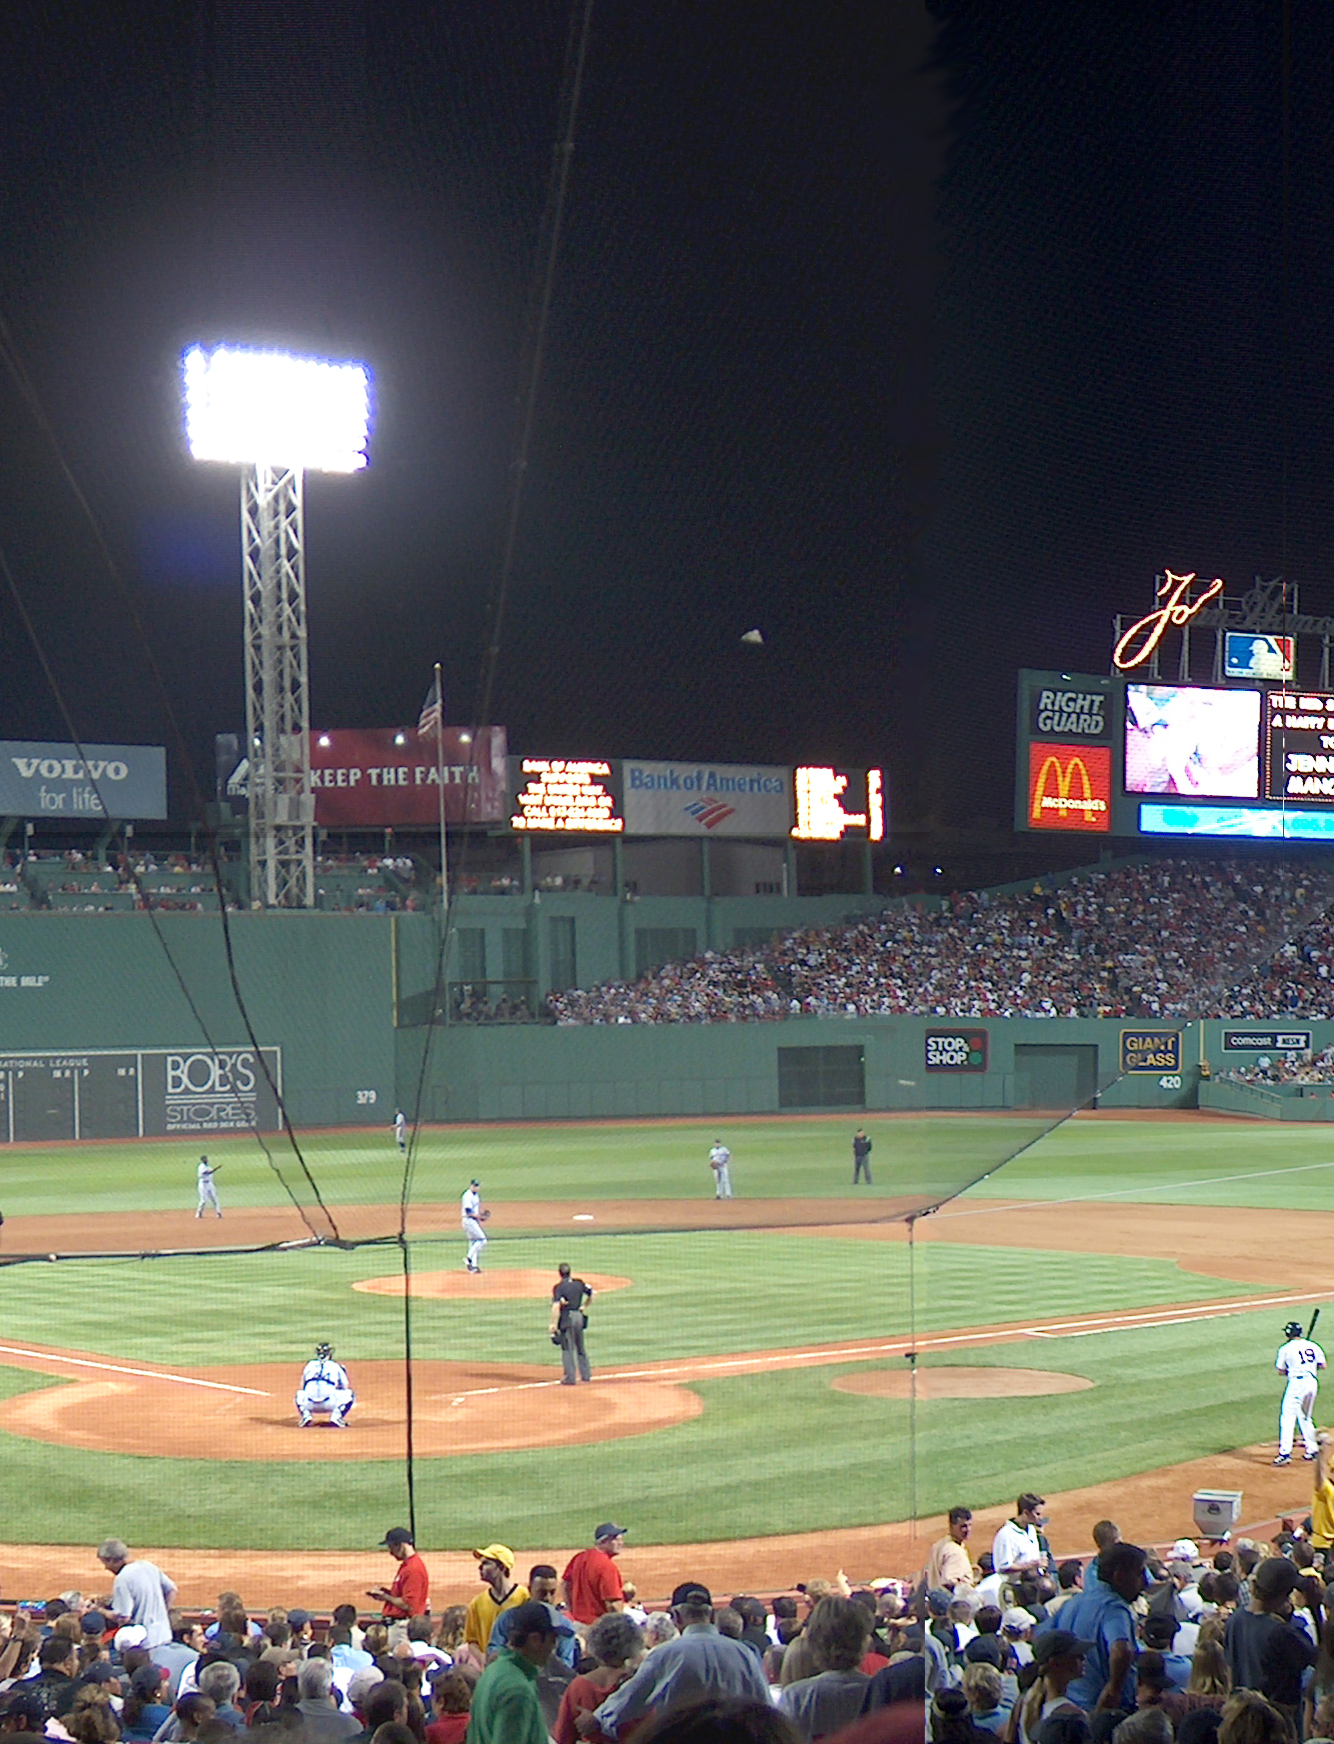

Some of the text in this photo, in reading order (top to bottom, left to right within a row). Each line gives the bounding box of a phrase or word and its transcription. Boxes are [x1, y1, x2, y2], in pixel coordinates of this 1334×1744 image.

[1038, 690, 1105, 715] RIGHT
[1038, 710, 1105, 735] GUARD
[11, 757, 129, 780] VOLVO
[310, 766, 361, 787] KEEP
[367, 766, 409, 786] THE
[630, 768, 784, 794] Bank of America
[39, 785, 103, 811] for life
[1041, 796, 1107, 812] McDonald's
[927, 1036, 965, 1051] STOP
[1125, 1036, 1176, 1051] GIANT
[1230, 1035, 1272, 1046] comcast
[49, 1058, 89, 1067] LEAGUE
[927, 1051, 967, 1065] SHOP
[1125, 1052, 1176, 1067] GLASS
[166, 1053, 256, 1094] BOB'S
[1158, 1076, 1182, 1090] 420
[166, 1103, 257, 1122] STORES
[1298, 1348, 1316, 1365] 19
